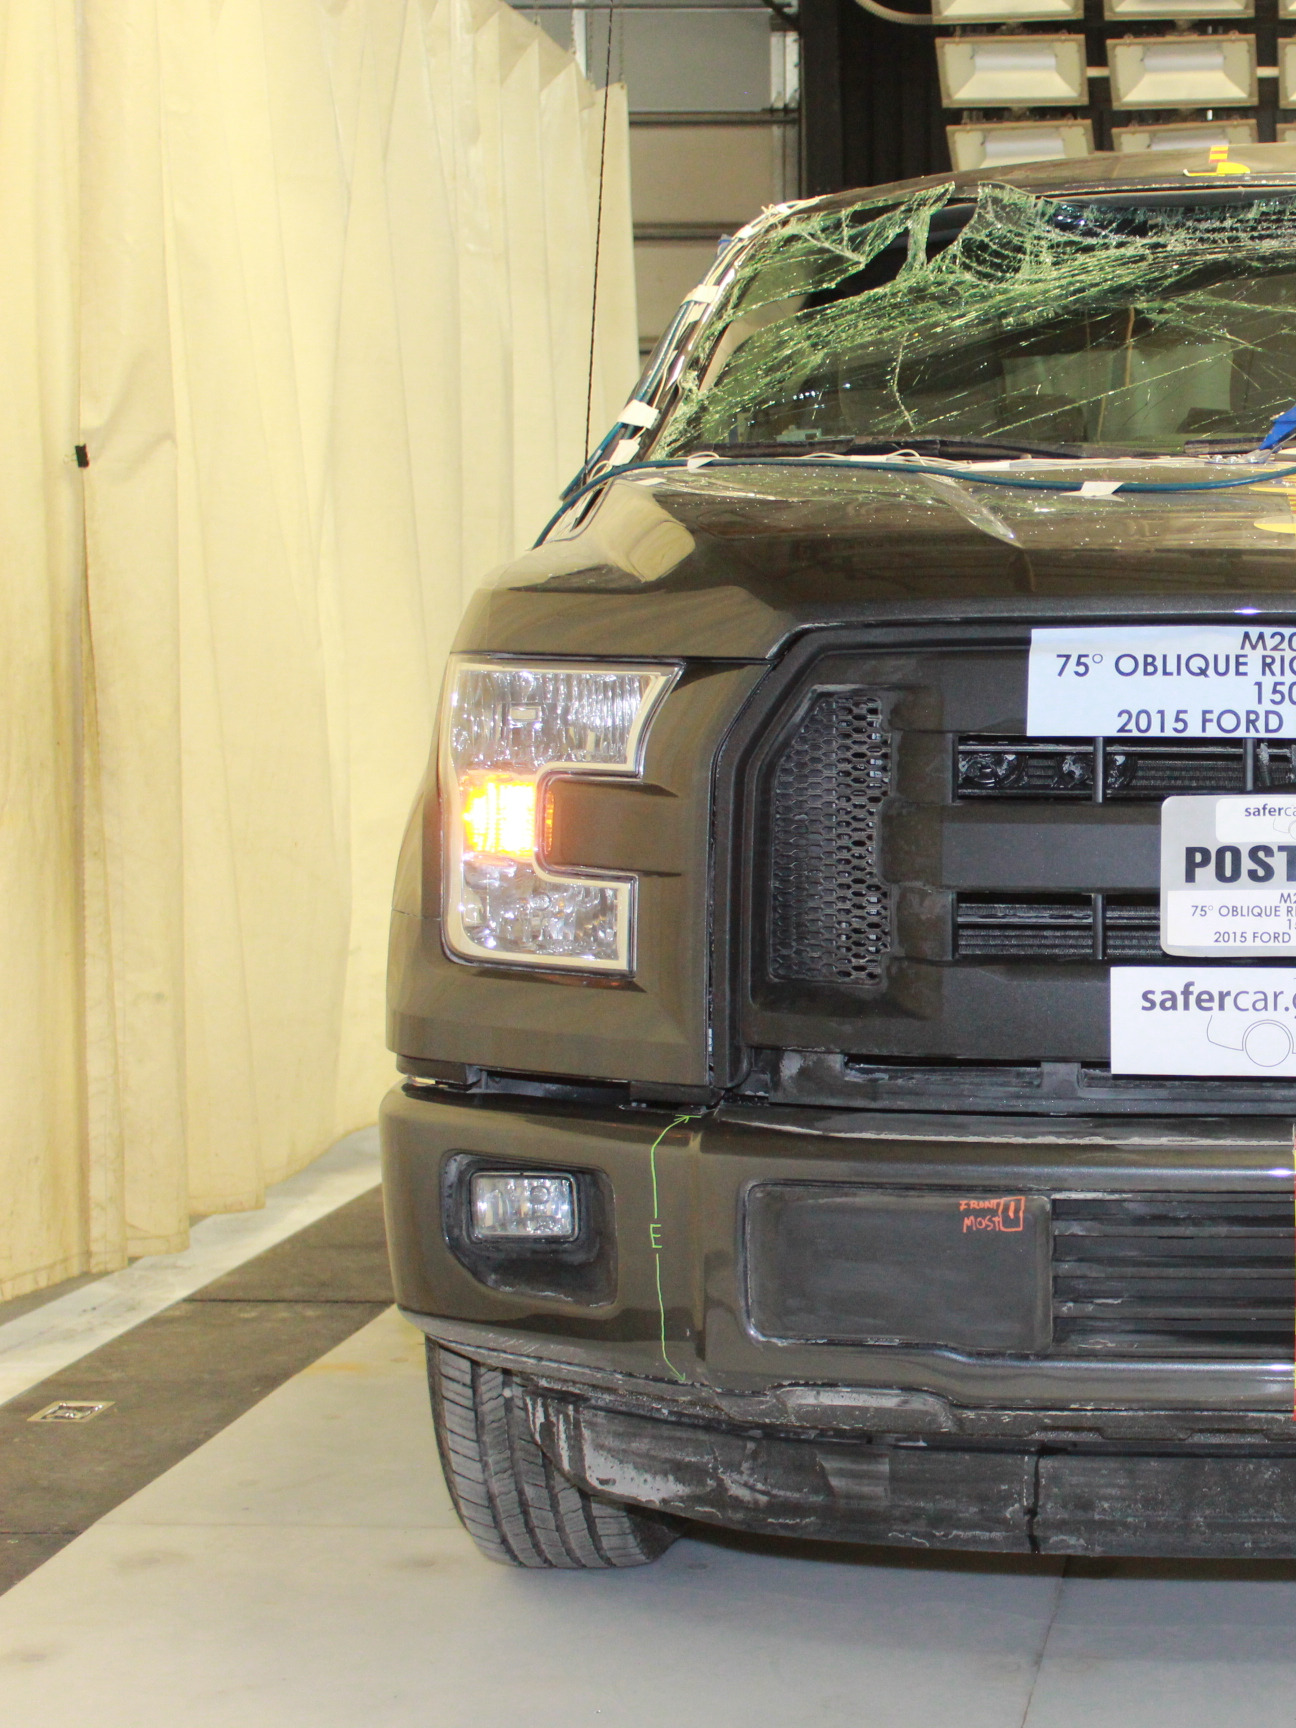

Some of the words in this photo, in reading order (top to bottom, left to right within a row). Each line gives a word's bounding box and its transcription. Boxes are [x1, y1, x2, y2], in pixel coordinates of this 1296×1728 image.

[1115, 654, 1248, 678] OBLIQUE
[1117, 711, 1188, 734] 2015
[1202, 711, 1283, 734] FORD
[1219, 906, 1280, 917] OBLIQUE
[1214, 932, 1247, 943] 2015
[1253, 932, 1291, 944] FORD
[963, 1215, 1000, 1233] MOST
